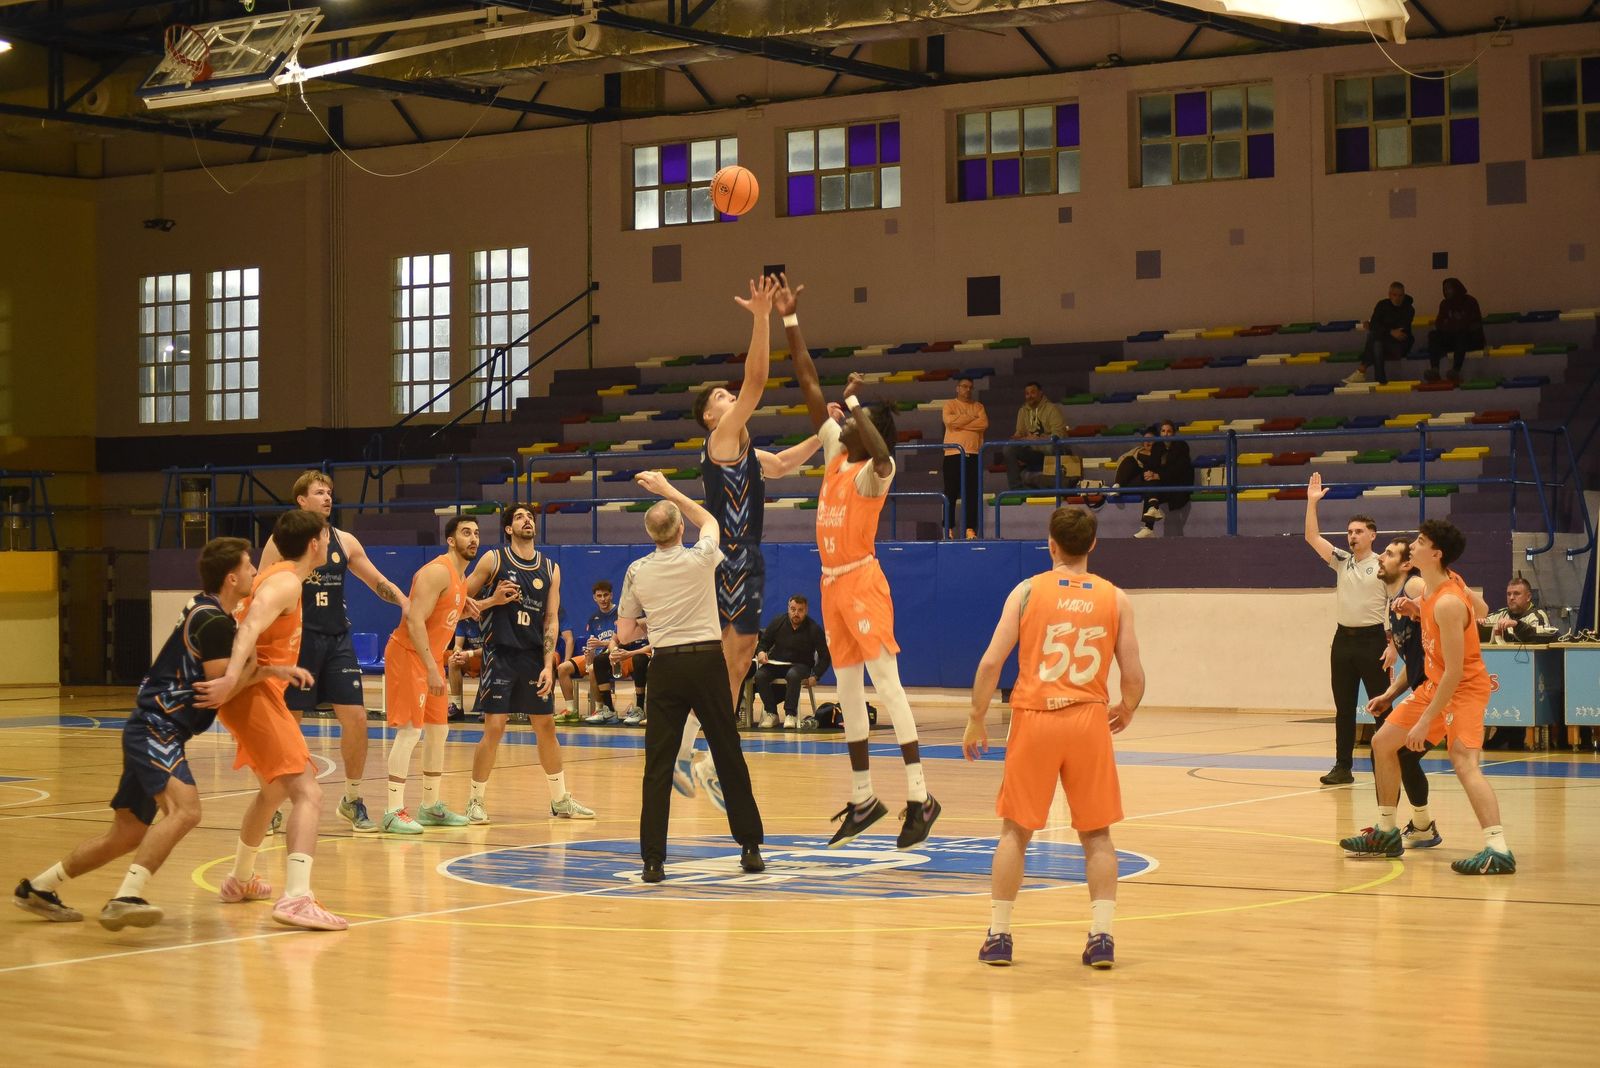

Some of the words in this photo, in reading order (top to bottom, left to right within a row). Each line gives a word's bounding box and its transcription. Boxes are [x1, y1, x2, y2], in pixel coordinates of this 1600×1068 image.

[315, 591, 329, 607] 15
[1056, 598, 1094, 614] MARIO
[517, 610, 531, 627] 10
[1038, 622, 1108, 686] 55
